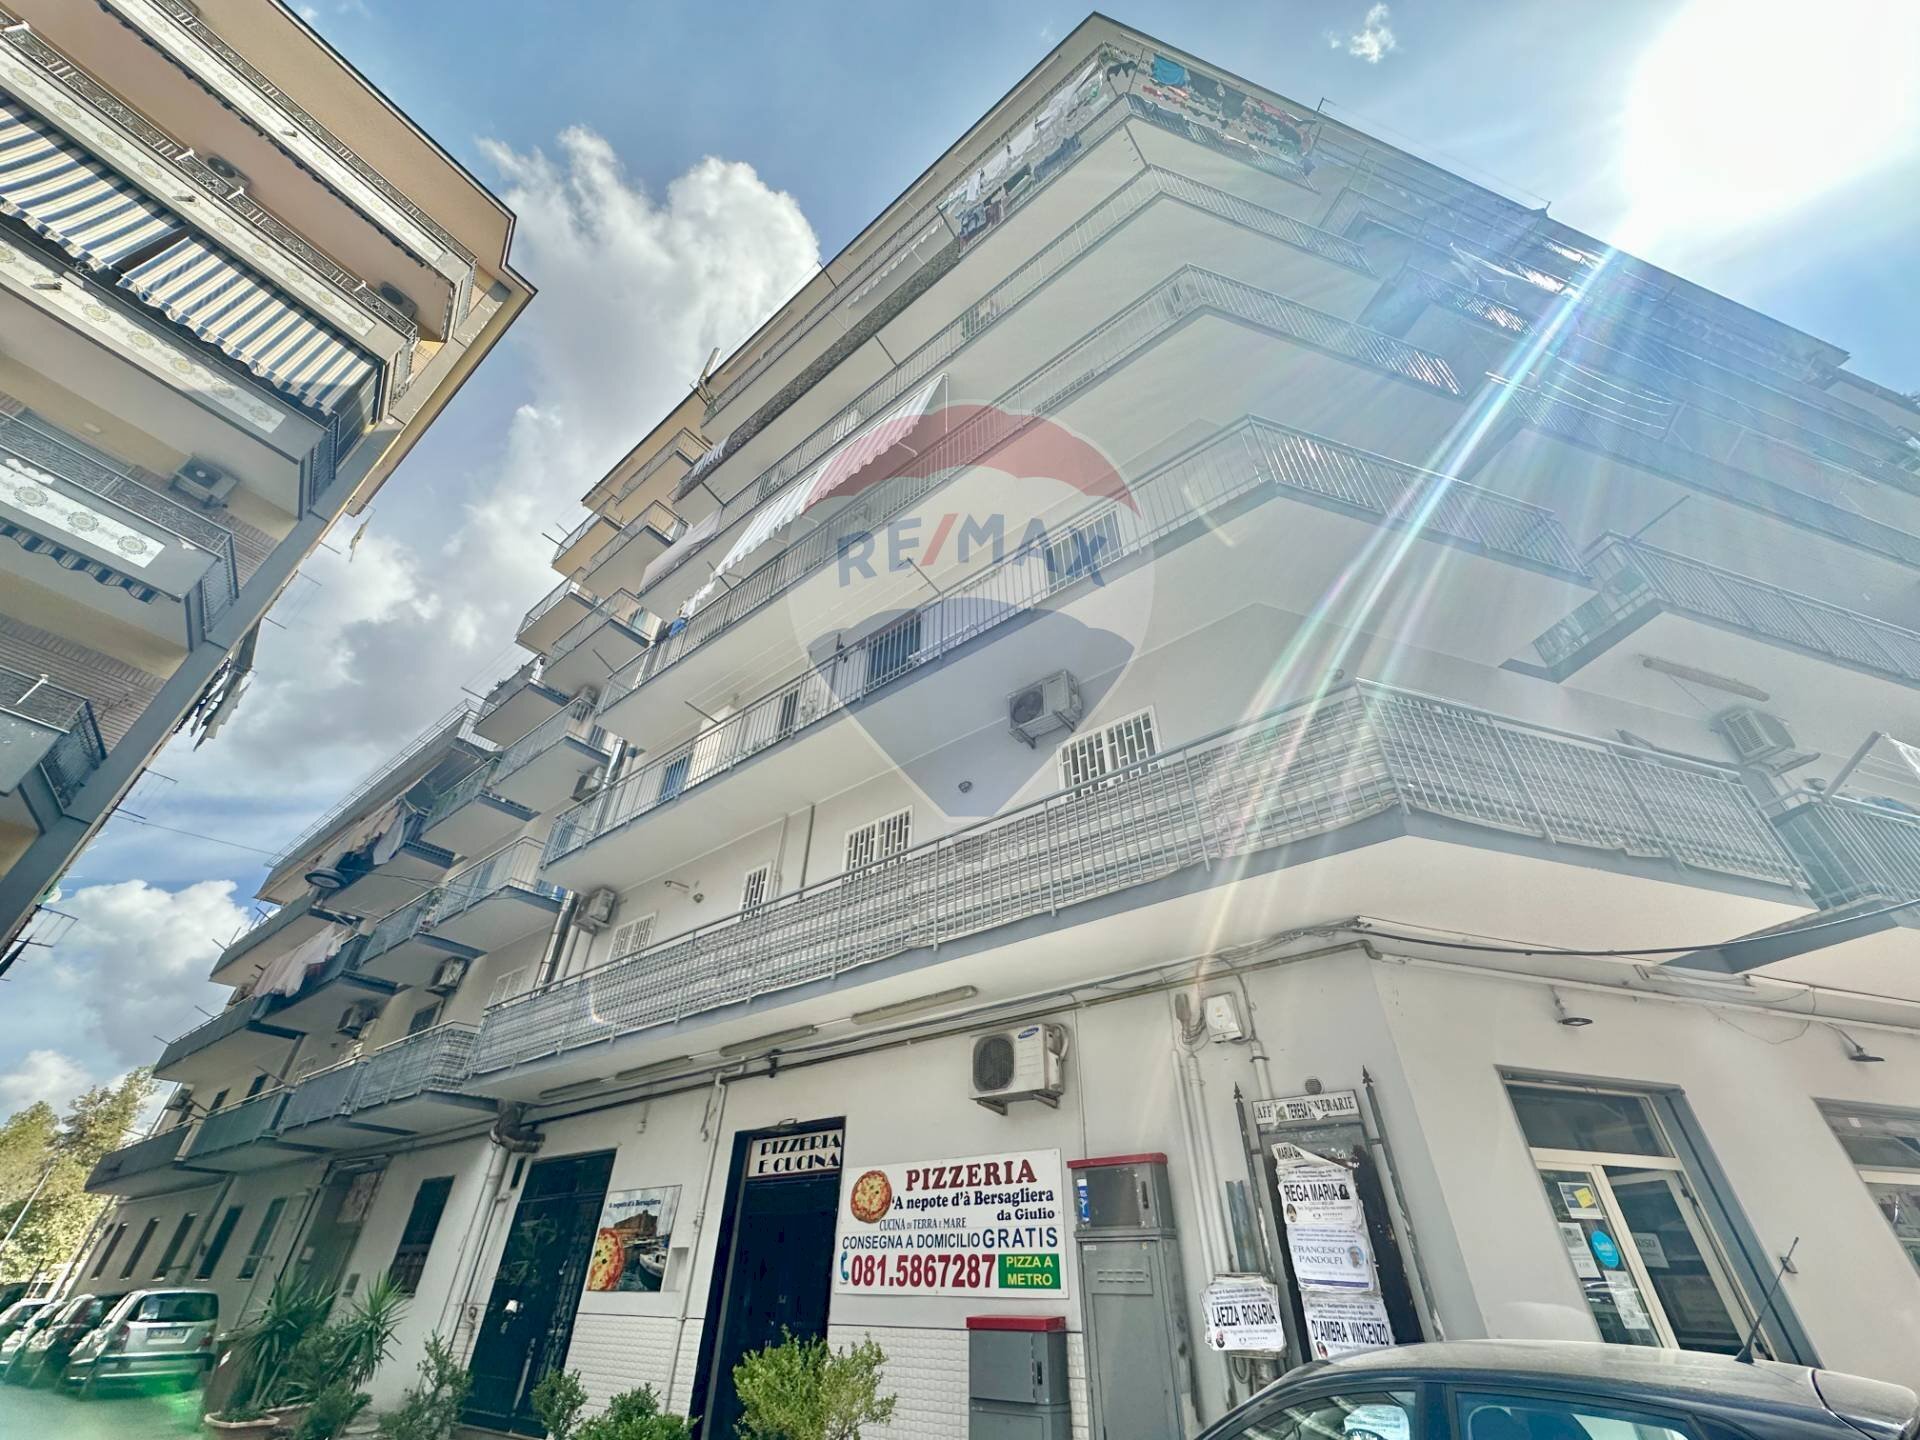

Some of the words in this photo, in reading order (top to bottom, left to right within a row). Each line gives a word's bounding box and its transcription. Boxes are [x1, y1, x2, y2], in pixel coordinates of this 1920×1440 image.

[760, 1133, 841, 1156] PIZZERIA
[758, 1159, 769, 1174] E
[773, 1152, 841, 1173] CUCINA
[905, 1159, 1038, 1192] PIZZERIA
[906, 1196, 949, 1212] nepote
[973, 1187, 1054, 1208] Bersagliera
[1283, 1184, 1311, 1202] REGA
[1310, 1184, 1340, 1201] MARIA
[879, 1218, 906, 1231] CUCINA
[913, 1218, 938, 1230] TERRA
[943, 1217, 967, 1229] MARE
[997, 1209, 1011, 1221] da
[1014, 1208, 1056, 1221] Giulio
[842, 1234, 904, 1250] CONSEGNA
[905, 1234, 914, 1249] A
[917, 1233, 981, 1249] DOMICILIO
[982, 1227, 1059, 1249] GRATIS
[1293, 1245, 1346, 1255] FRANCESCO
[1298, 1255, 1343, 1265] PANDOLFI
[850, 1253, 997, 1289] 081.5867287
[1005, 1256, 1040, 1268] PIZZA
[1043, 1256, 1053, 1268] A
[1007, 1273, 1053, 1286] METRO
[1212, 1305, 1241, 1327] LAEZZA
[1241, 1303, 1277, 1325] ROSARIA
[1311, 1320, 1349, 1343] D'AMBRA
[1348, 1321, 1390, 1346] VINCENZO
